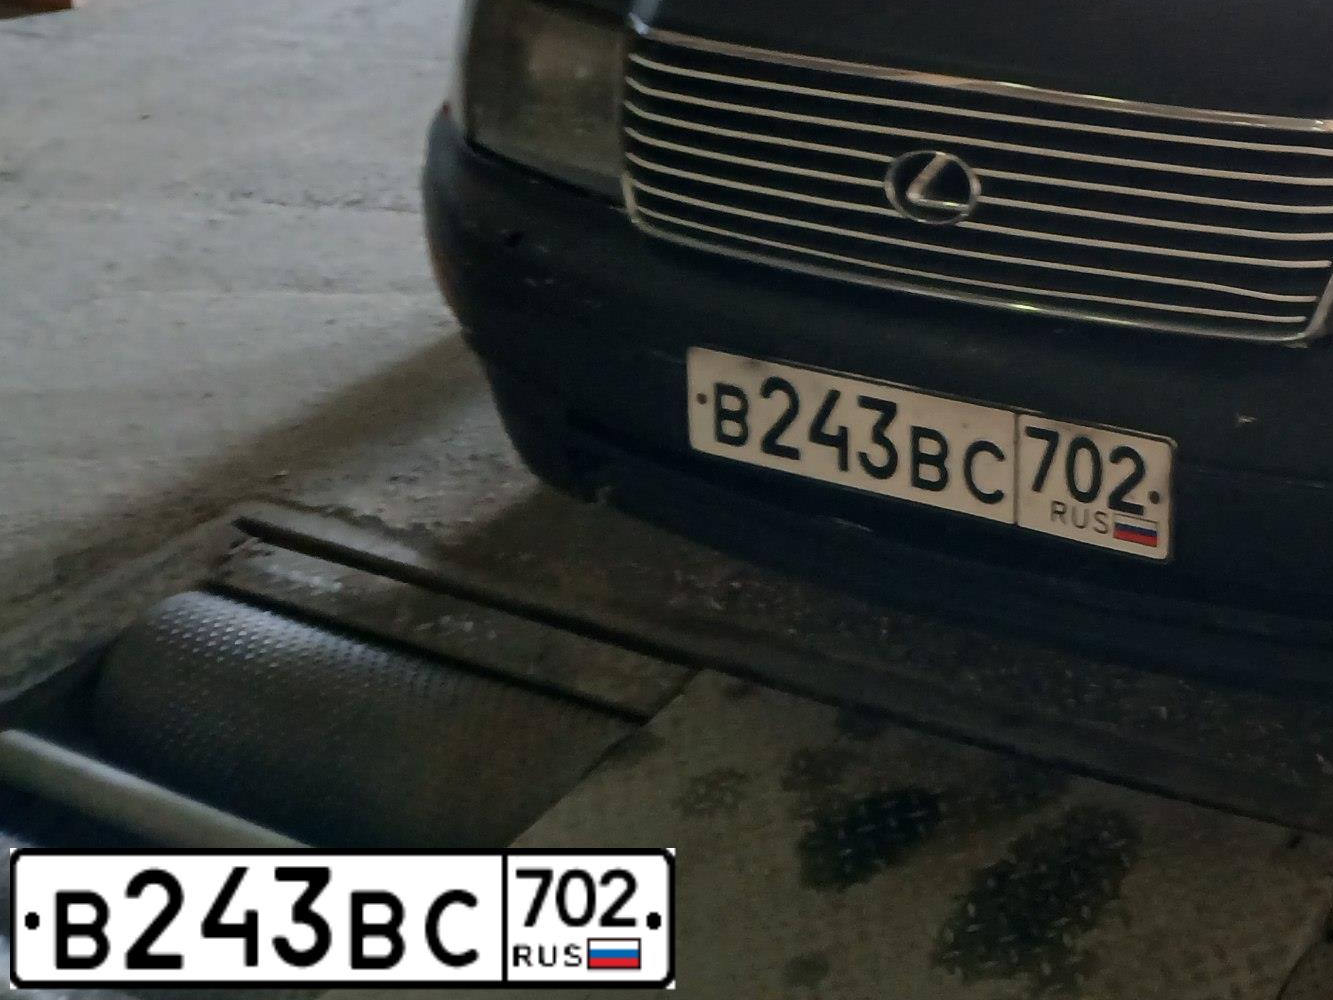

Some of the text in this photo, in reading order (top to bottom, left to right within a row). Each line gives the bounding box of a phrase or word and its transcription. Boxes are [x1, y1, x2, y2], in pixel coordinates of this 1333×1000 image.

[714, 375, 1146, 516] B243BC 702
[1051, 501, 1110, 535] RUS
